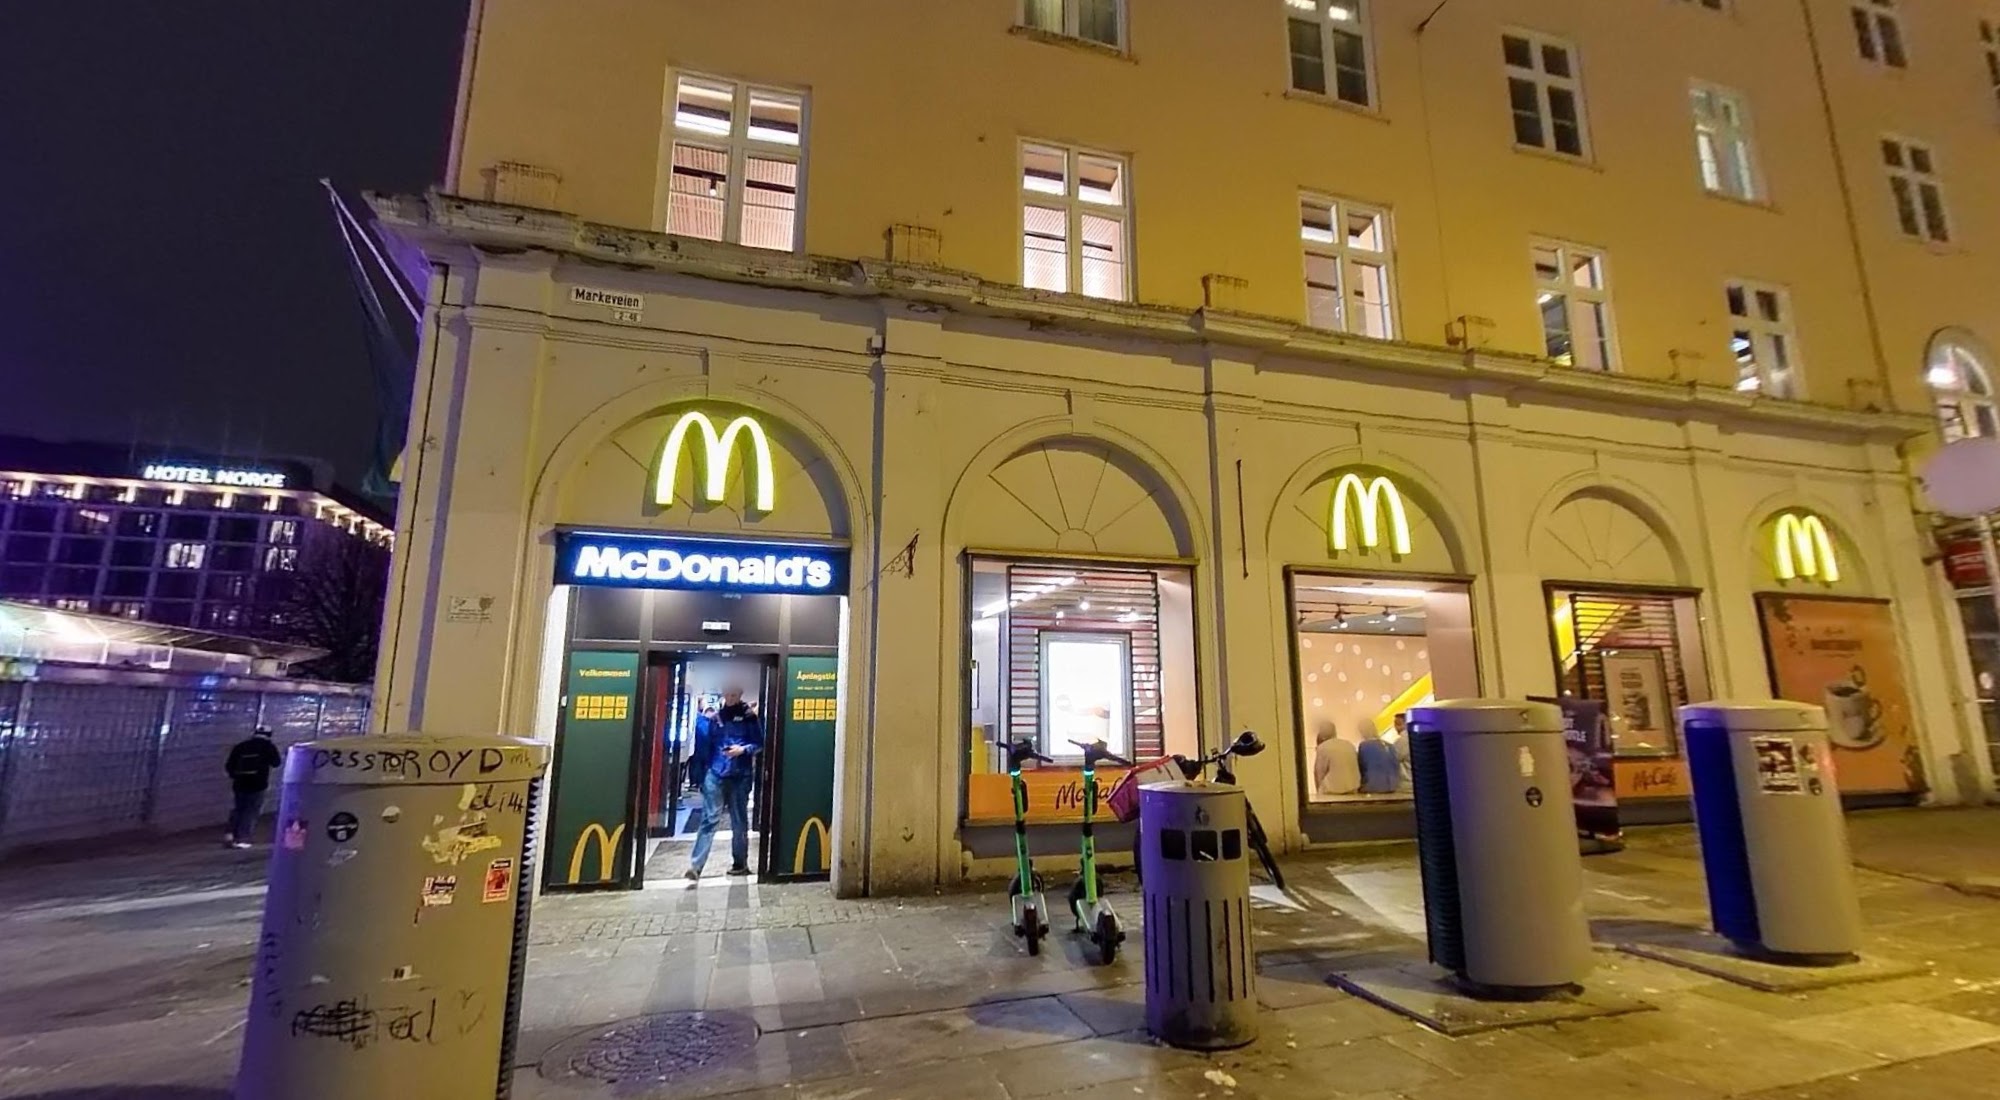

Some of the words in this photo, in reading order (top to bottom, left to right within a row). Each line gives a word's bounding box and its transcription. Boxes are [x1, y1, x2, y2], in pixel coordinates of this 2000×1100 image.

[575, 288, 640, 308] Markeveien
[144, 464, 212, 483] HOTEL
[215, 469, 286, 488] NORGE
[575, 546, 831, 587] McDonald's
